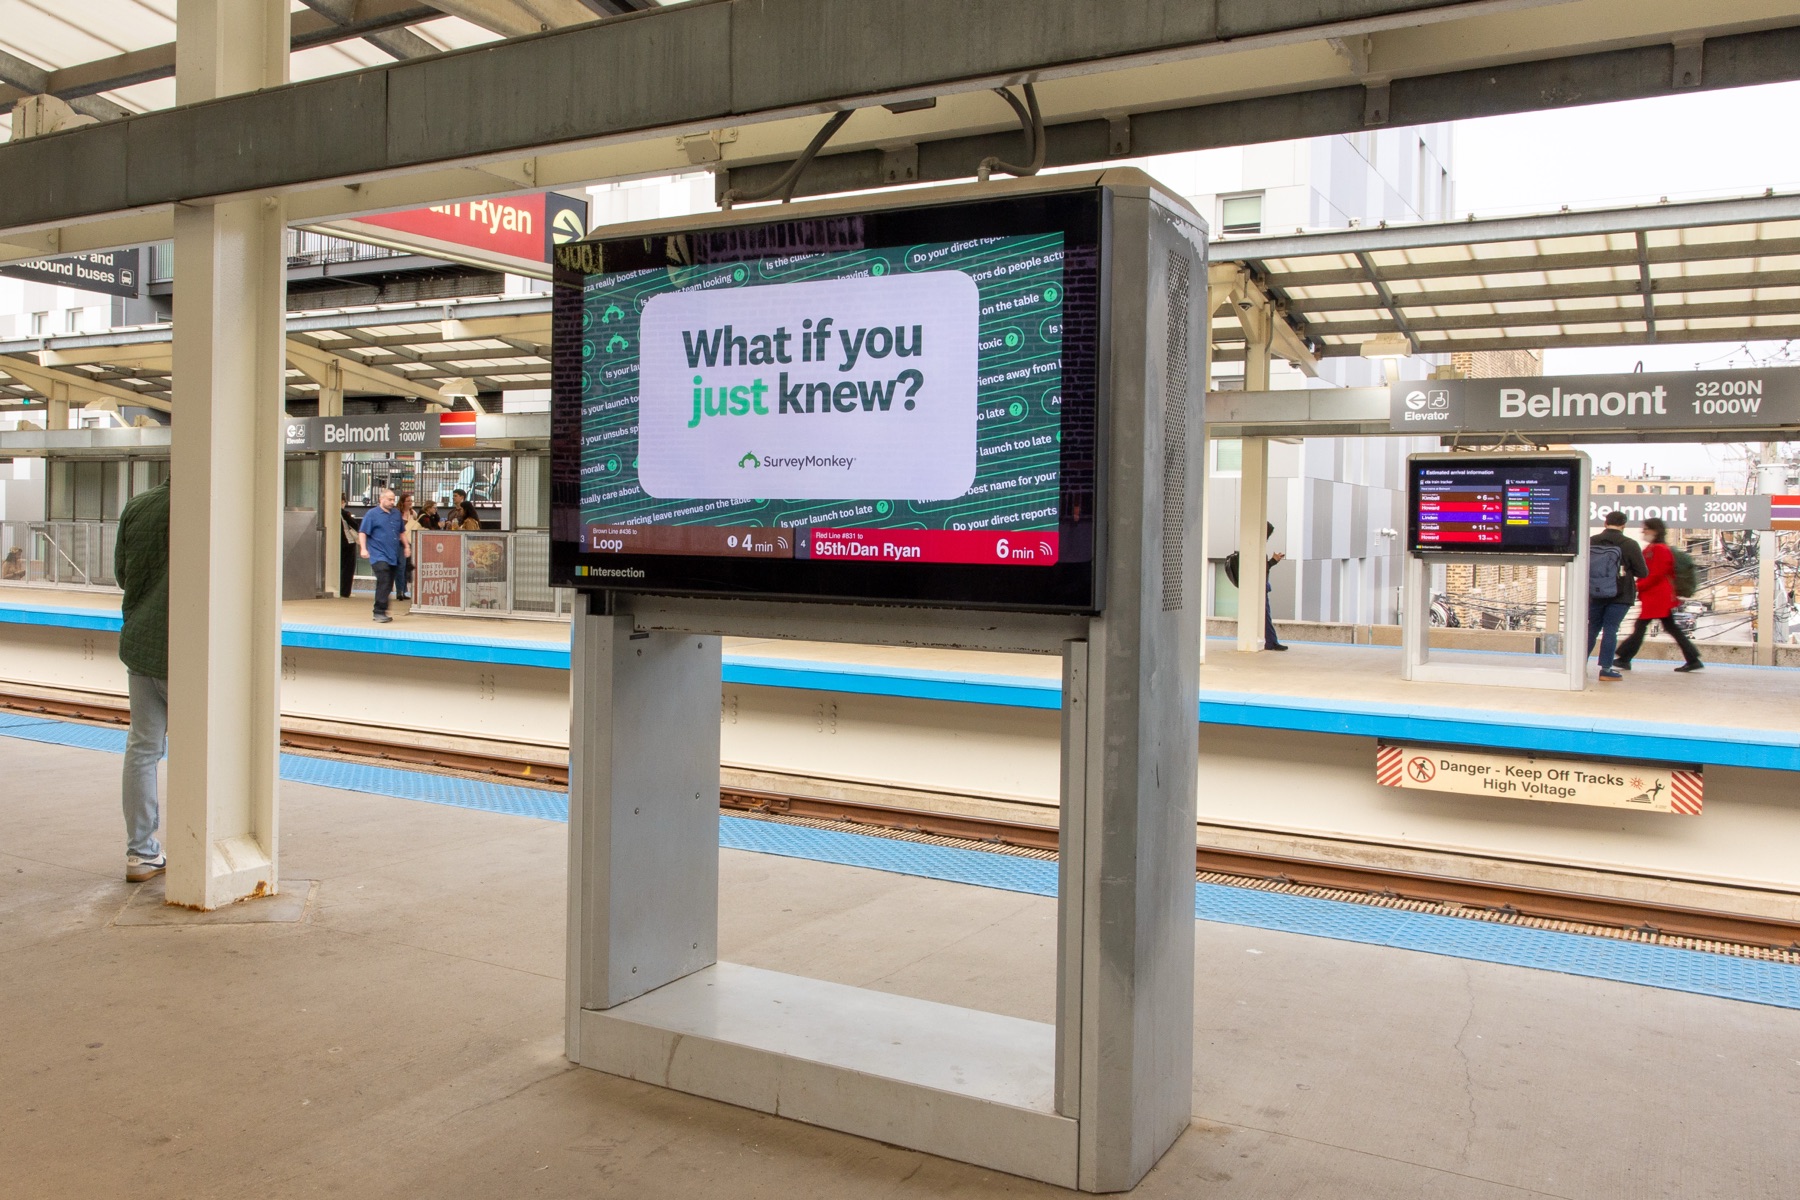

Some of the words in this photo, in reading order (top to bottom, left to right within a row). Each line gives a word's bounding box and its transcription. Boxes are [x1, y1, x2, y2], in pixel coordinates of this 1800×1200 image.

[470, 200, 532, 235] Ryan
[90, 253, 114, 266] and
[913, 253, 927, 263] Do
[928, 247, 948, 262] your
[950, 238, 979, 253] direct
[77, 264, 115, 283] buses
[765, 262, 774, 270] Is
[774, 258, 789, 268] the
[994, 266, 1007, 277] do
[1008, 256, 1042, 275] people
[595, 277, 615, 289] really
[616, 270, 637, 283] boost
[702, 273, 732, 288] looking
[981, 306, 995, 316] on
[995, 300, 1013, 312] the
[1013, 293, 1040, 307] table
[1049, 325, 1058, 334] Is
[682, 325, 792, 368] What
[802, 318, 834, 362] if
[838, 324, 922, 372] you
[978, 338, 1003, 351] toxic
[605, 370, 613, 379] Is
[612, 366, 629, 378] your
[1006, 366, 1031, 379] away
[1032, 361, 1057, 374] from
[588, 404, 605, 416] your
[605, 397, 630, 410] launch
[688, 375, 769, 428] just
[778, 368, 924, 415] knew?
[1500, 385, 1667, 419] Belmont
[1695, 379, 1763, 397] 3200N
[1691, 397, 1761, 415] 1000W
[986, 408, 1005, 419] late
[1404, 411, 1450, 422] Elevator
[324, 423, 390, 443] Belmont
[400, 421, 426, 431] 3200N
[399, 432, 426, 442] 1000W
[585, 434, 602, 446] your
[603, 427, 629, 440] unsubs
[979, 442, 1012, 457] launch
[1014, 441, 1031, 450] too
[1032, 435, 1052, 447] late
[580, 463, 605, 476] morale
[989, 479, 1017, 491] name
[1018, 474, 1033, 487] for
[1033, 471, 1057, 486] your
[580, 494, 601, 505] tually
[601, 491, 618, 500] care
[618, 485, 640, 497] about
[652, 511, 673, 522] leave
[673, 505, 704, 517] revenue
[704, 503, 715, 511] on
[715, 499, 730, 509] the
[780, 520, 788, 528] Is
[789, 516, 808, 528] your
[809, 509, 839, 524] launch
[839, 509, 855, 518] too
[855, 504, 873, 515] late
[1704, 501, 1747, 512] 3200N
[952, 522, 967, 531] Do
[967, 518, 989, 531] your
[990, 513, 1019, 526] direct
[1021, 506, 1058, 520] reports
[1702, 513, 1746, 523] 1000W
[593, 536, 623, 553] Loop
[742, 534, 753, 552] 4
[755, 542, 773, 552] min
[800, 540, 806, 548] 4
[815, 531, 828, 539] Red
[841, 532, 856, 540] #831
[857, 532, 864, 540] to
[815, 541, 879, 557] 95th/Dan
[883, 543, 921, 561] Ryan
[996, 538, 1009, 559] 6
[1012, 547, 1034, 559] min
[421, 569, 457, 577] DISCOVER
[590, 566, 645, 578] Intersection
[1440, 759, 1492, 775] Danger
[1505, 765, 1543, 781] Keep
[1547, 769, 1571, 782] Off
[1574, 771, 1624, 787] Tracks
[1483, 778, 1516, 794] High
[1521, 781, 1577, 798] Voltage
